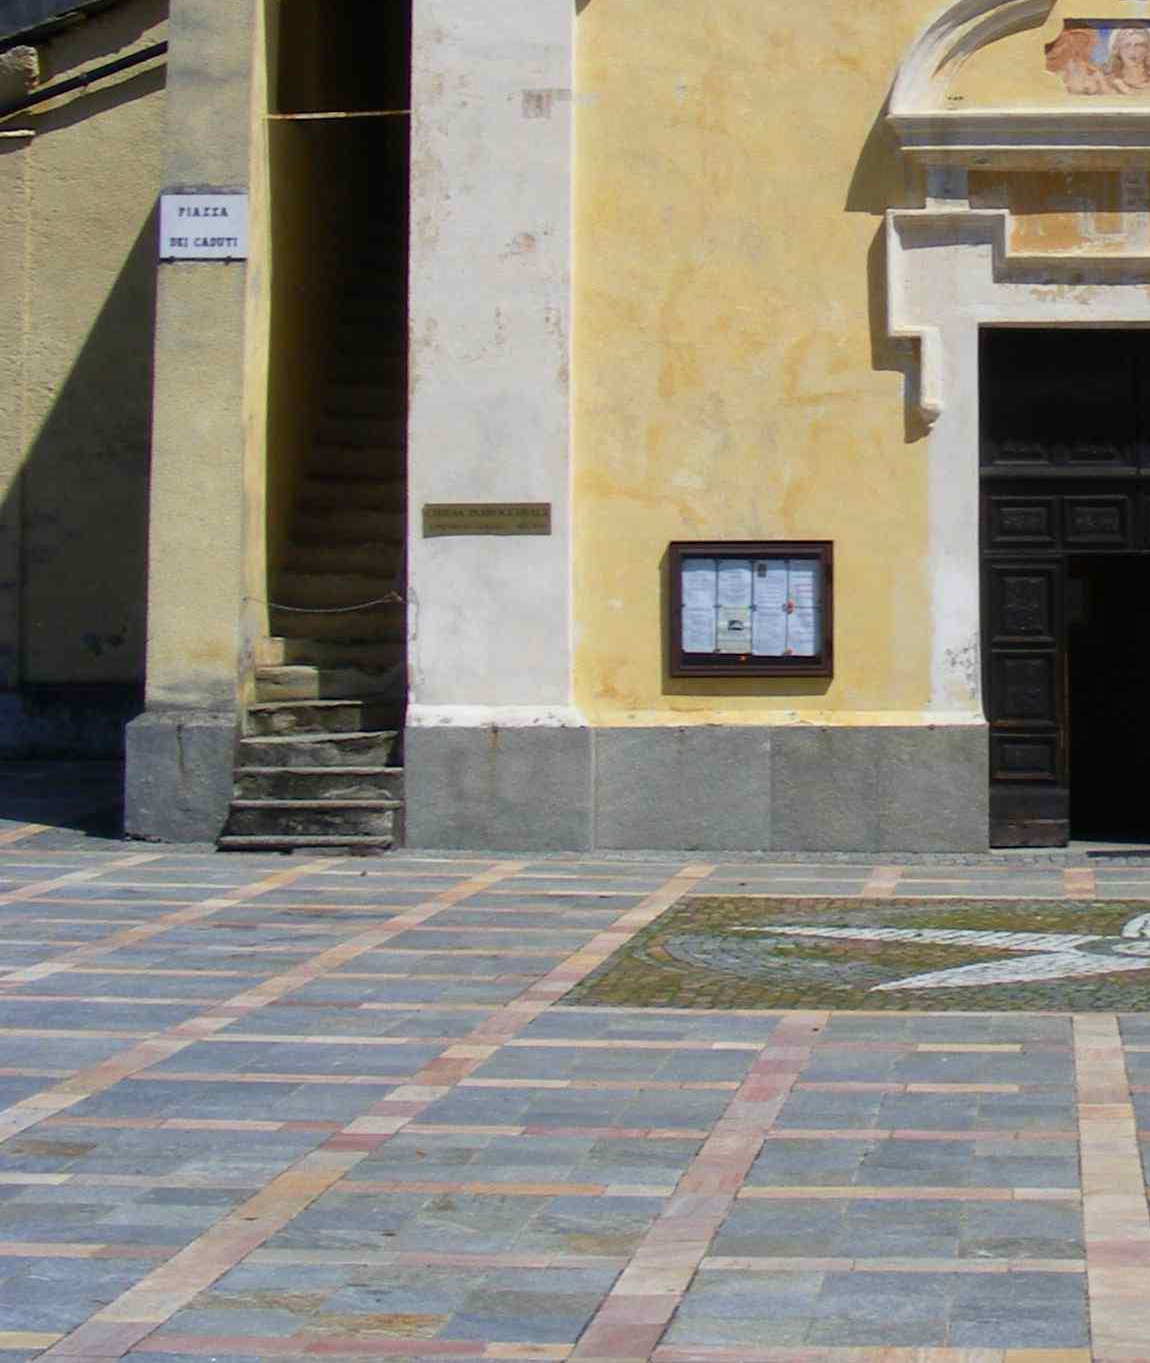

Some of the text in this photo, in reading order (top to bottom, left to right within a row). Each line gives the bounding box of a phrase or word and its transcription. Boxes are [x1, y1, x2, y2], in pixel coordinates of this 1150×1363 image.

[178, 207, 229, 217] PIAZZA
[170, 237, 238, 247] DEI CADUTI
